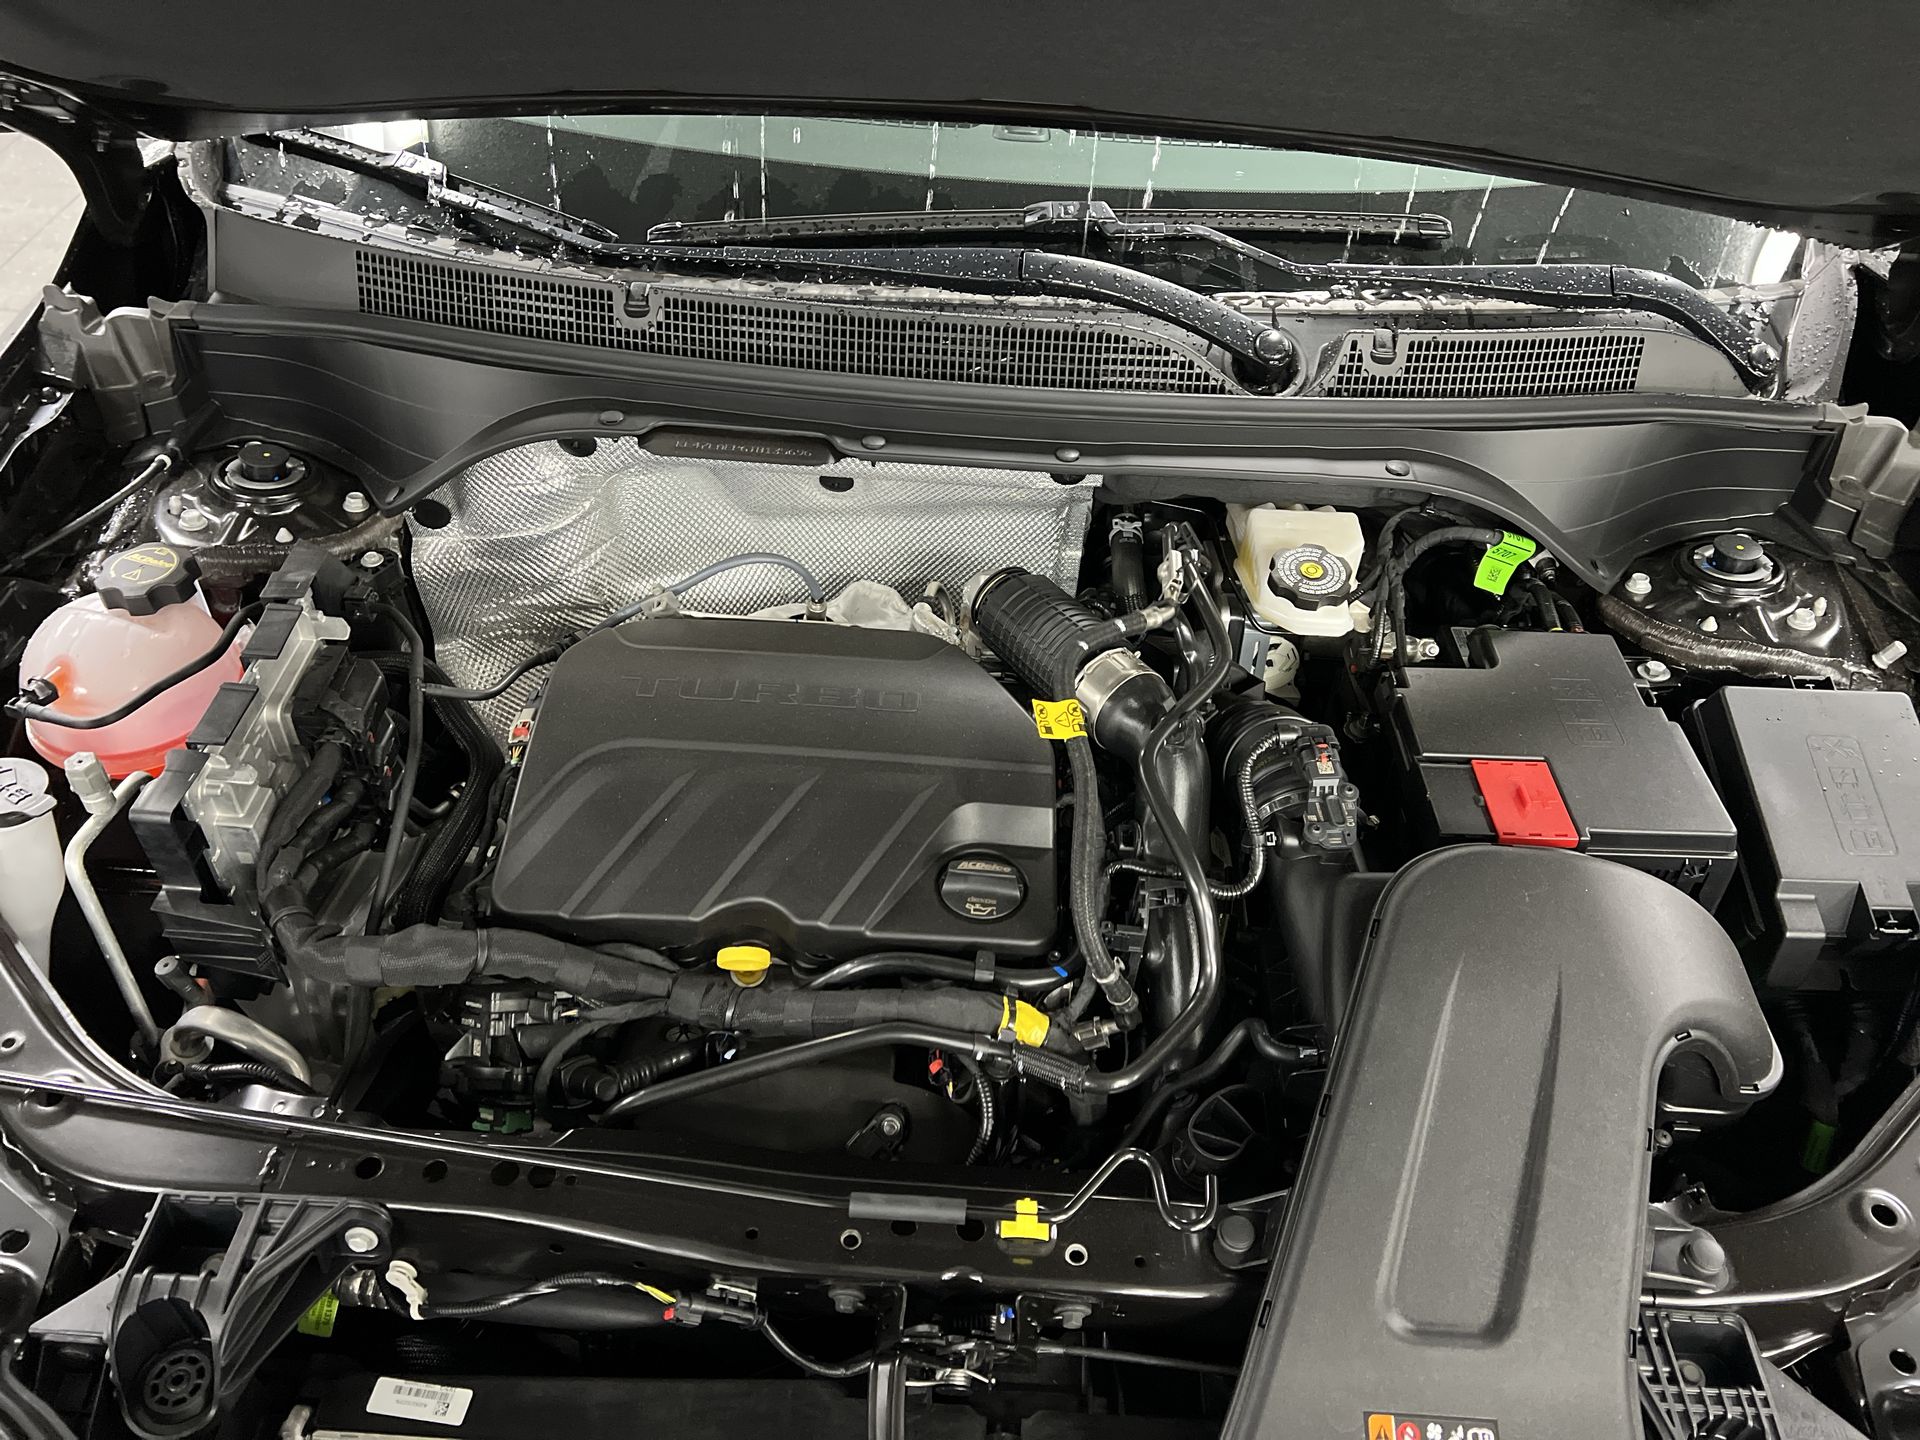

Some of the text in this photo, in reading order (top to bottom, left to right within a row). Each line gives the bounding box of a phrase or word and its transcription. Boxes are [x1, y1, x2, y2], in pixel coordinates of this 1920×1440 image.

[1491, 547, 1517, 559] 5707
[620, 675, 921, 713] TURBO
[957, 861, 1012, 873] ACDelco
